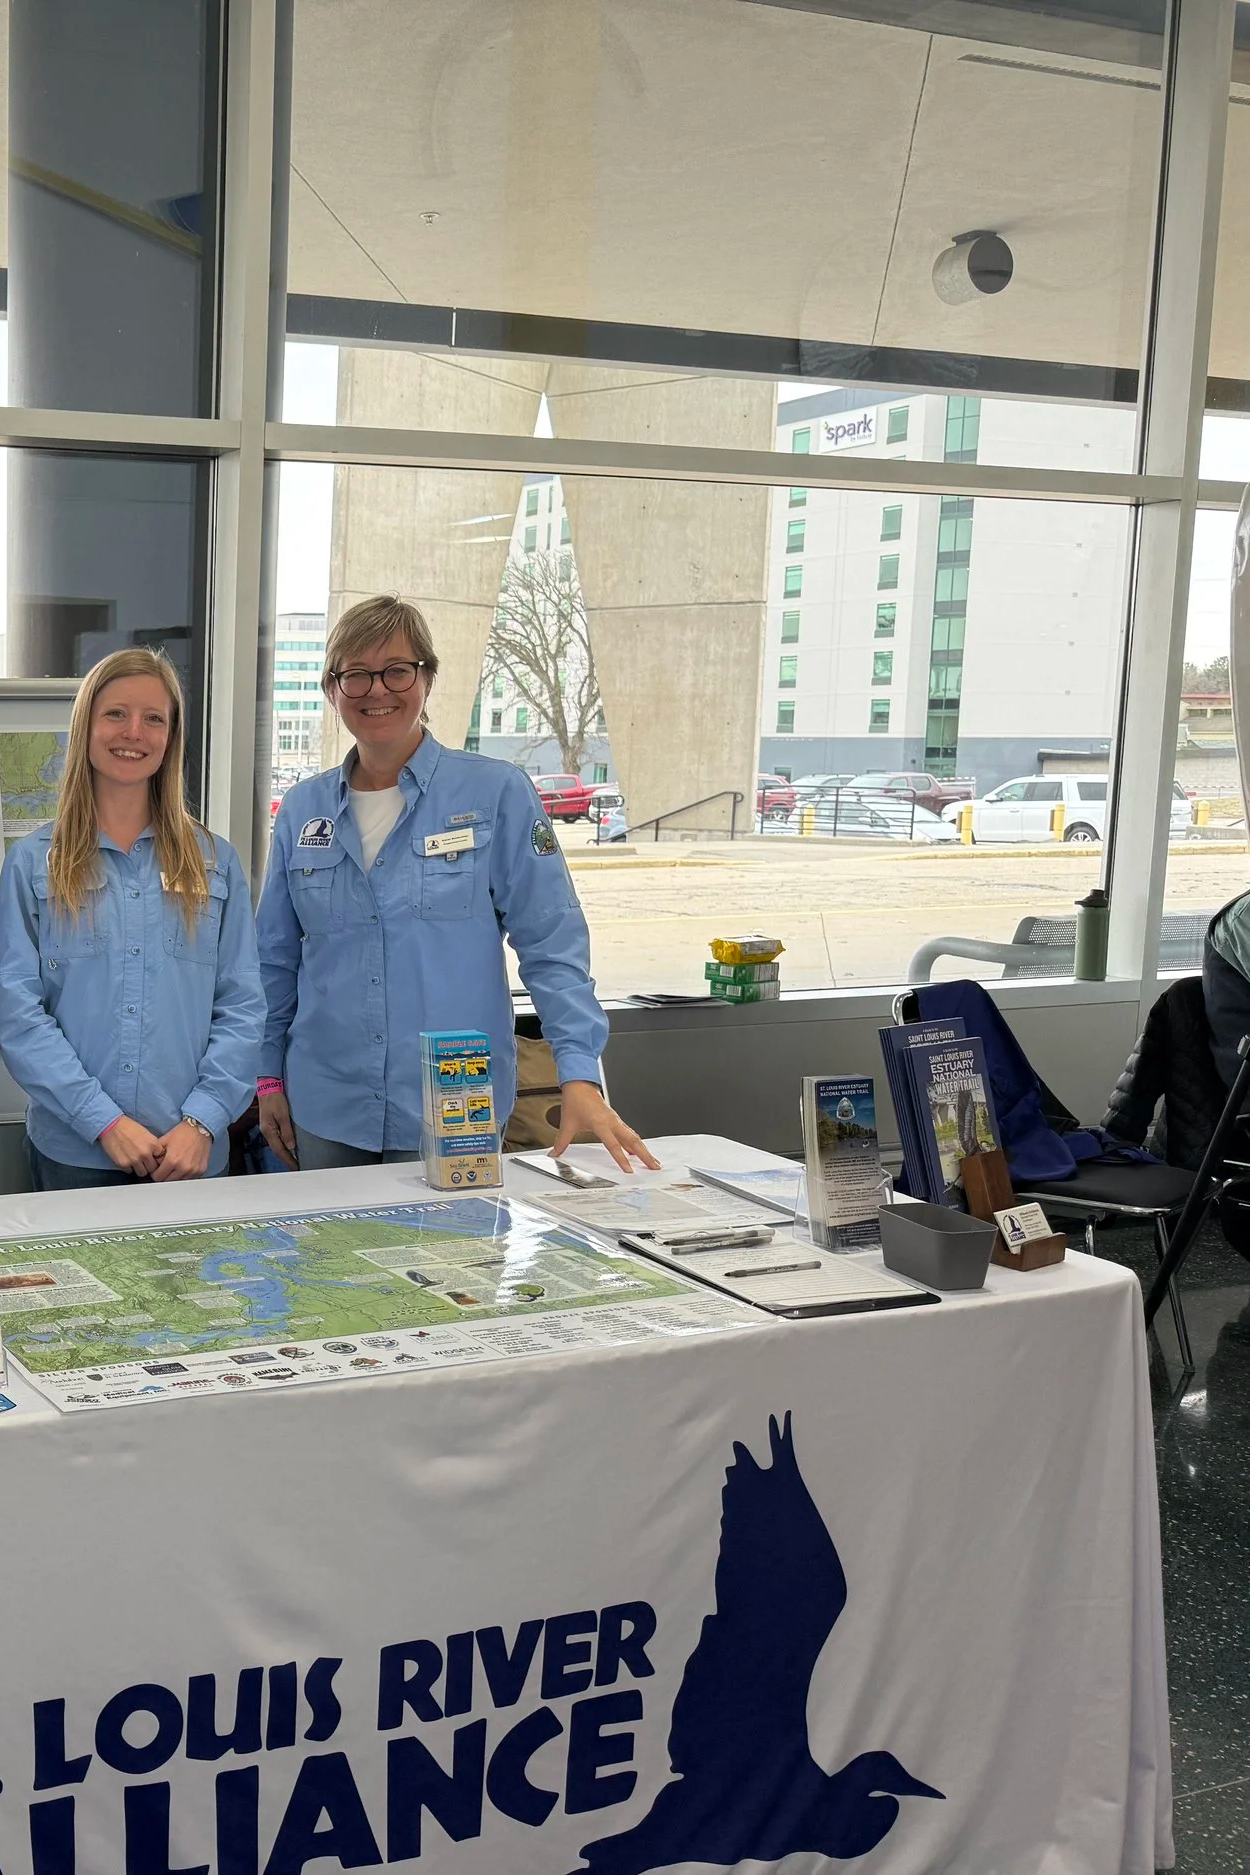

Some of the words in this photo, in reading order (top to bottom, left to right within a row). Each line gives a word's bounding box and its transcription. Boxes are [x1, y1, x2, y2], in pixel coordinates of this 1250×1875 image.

[825, 412, 873, 446] spark
[908, 1034, 924, 1043] SAINT
[924, 1032, 940, 1041] LOUIS
[929, 1055, 944, 1064] SAINT
[944, 1052, 959, 1061] LOUIS
[931, 1059, 975, 1074] ESTUARY
[932, 1069, 976, 1083] NATIONAL
[935, 1080, 959, 1095] WATER
[960, 1077, 980, 1091] TRAIL
[16, 1240, 82, 1253] Louis
[85, 1234, 147, 1246] River
[149, 1226, 237, 1239] Estuary
[234, 1214, 333, 1230] National
[333, 1208, 398, 1220] Water
[398, 1202, 454, 1213] Trail
[38, 1369, 85, 1379] SILVER
[92, 1360, 160, 1372] SPONSORS
[31, 1656, 344, 1792] LOUIS
[376, 1600, 658, 1732] RIVER
